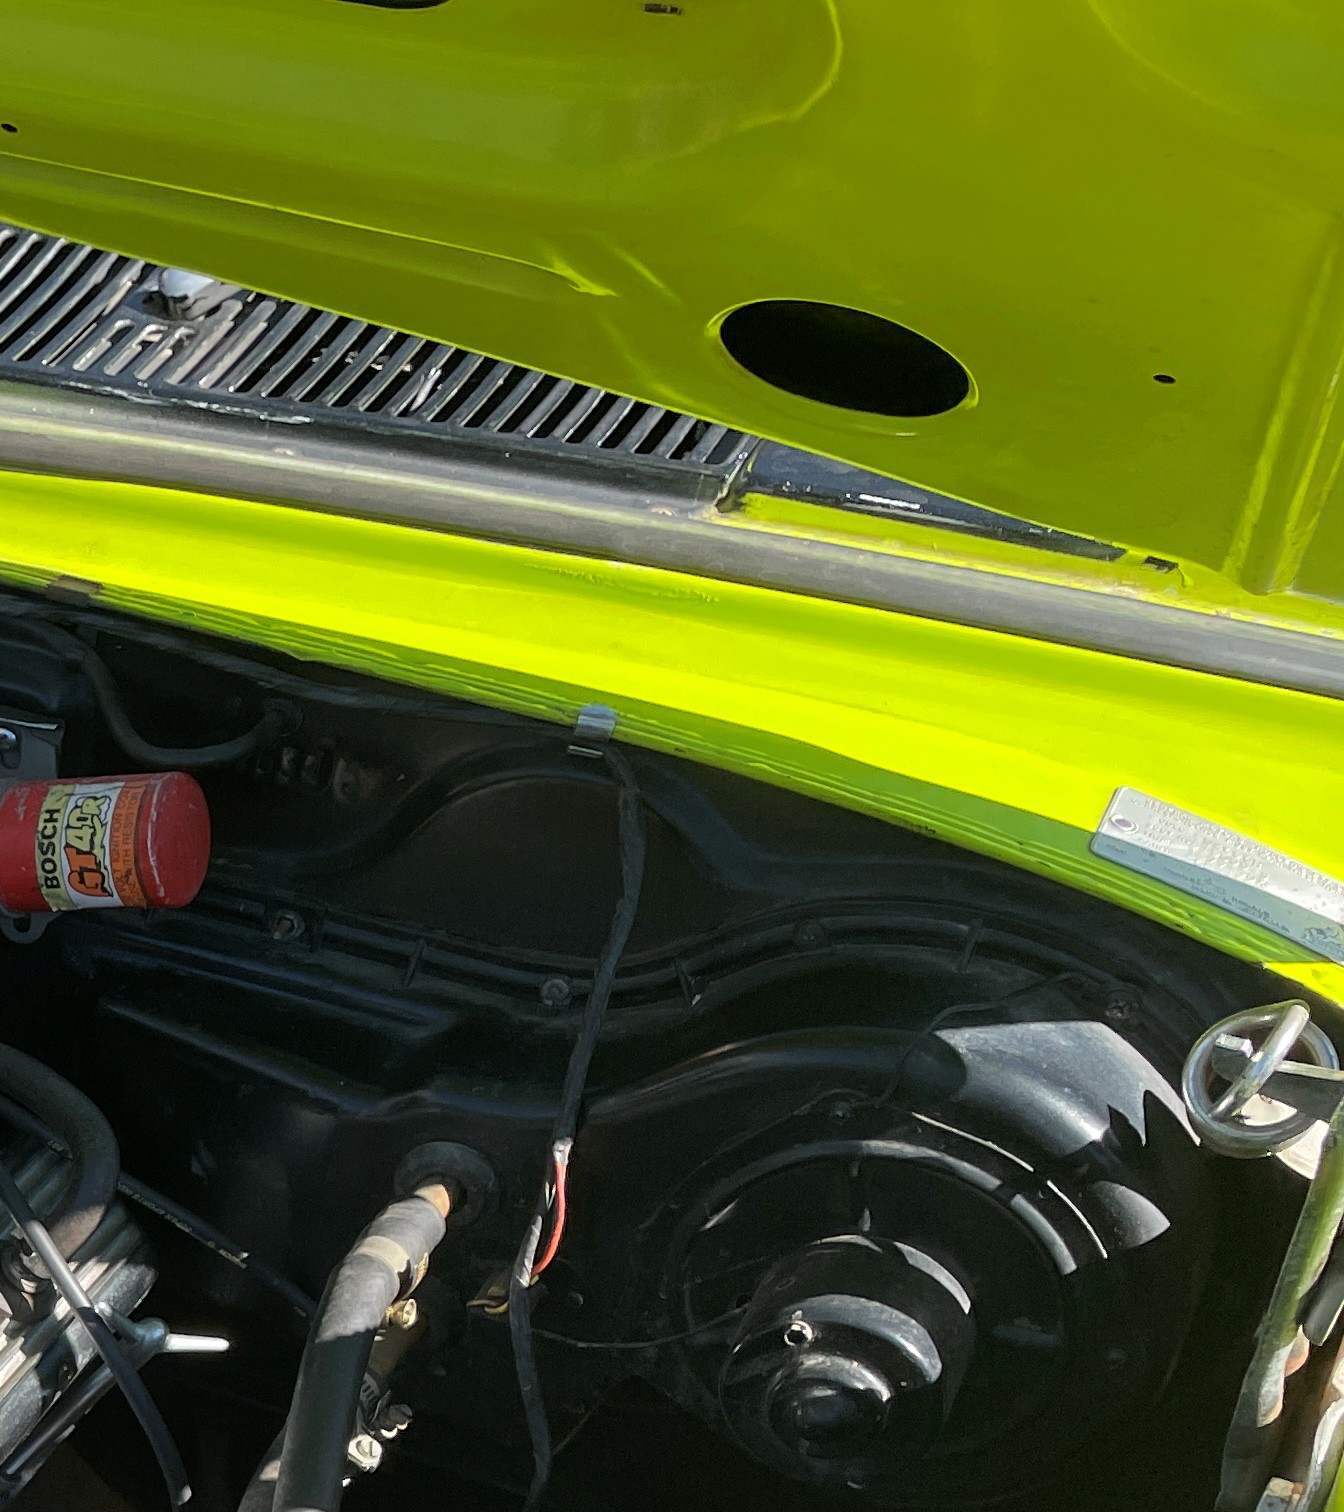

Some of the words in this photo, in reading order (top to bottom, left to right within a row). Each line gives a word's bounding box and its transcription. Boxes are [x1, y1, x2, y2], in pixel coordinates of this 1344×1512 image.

[41, 808, 61, 889] BOSCH
[64, 796, 113, 897] GT40R
[112, 812, 123, 863] IGNITION
